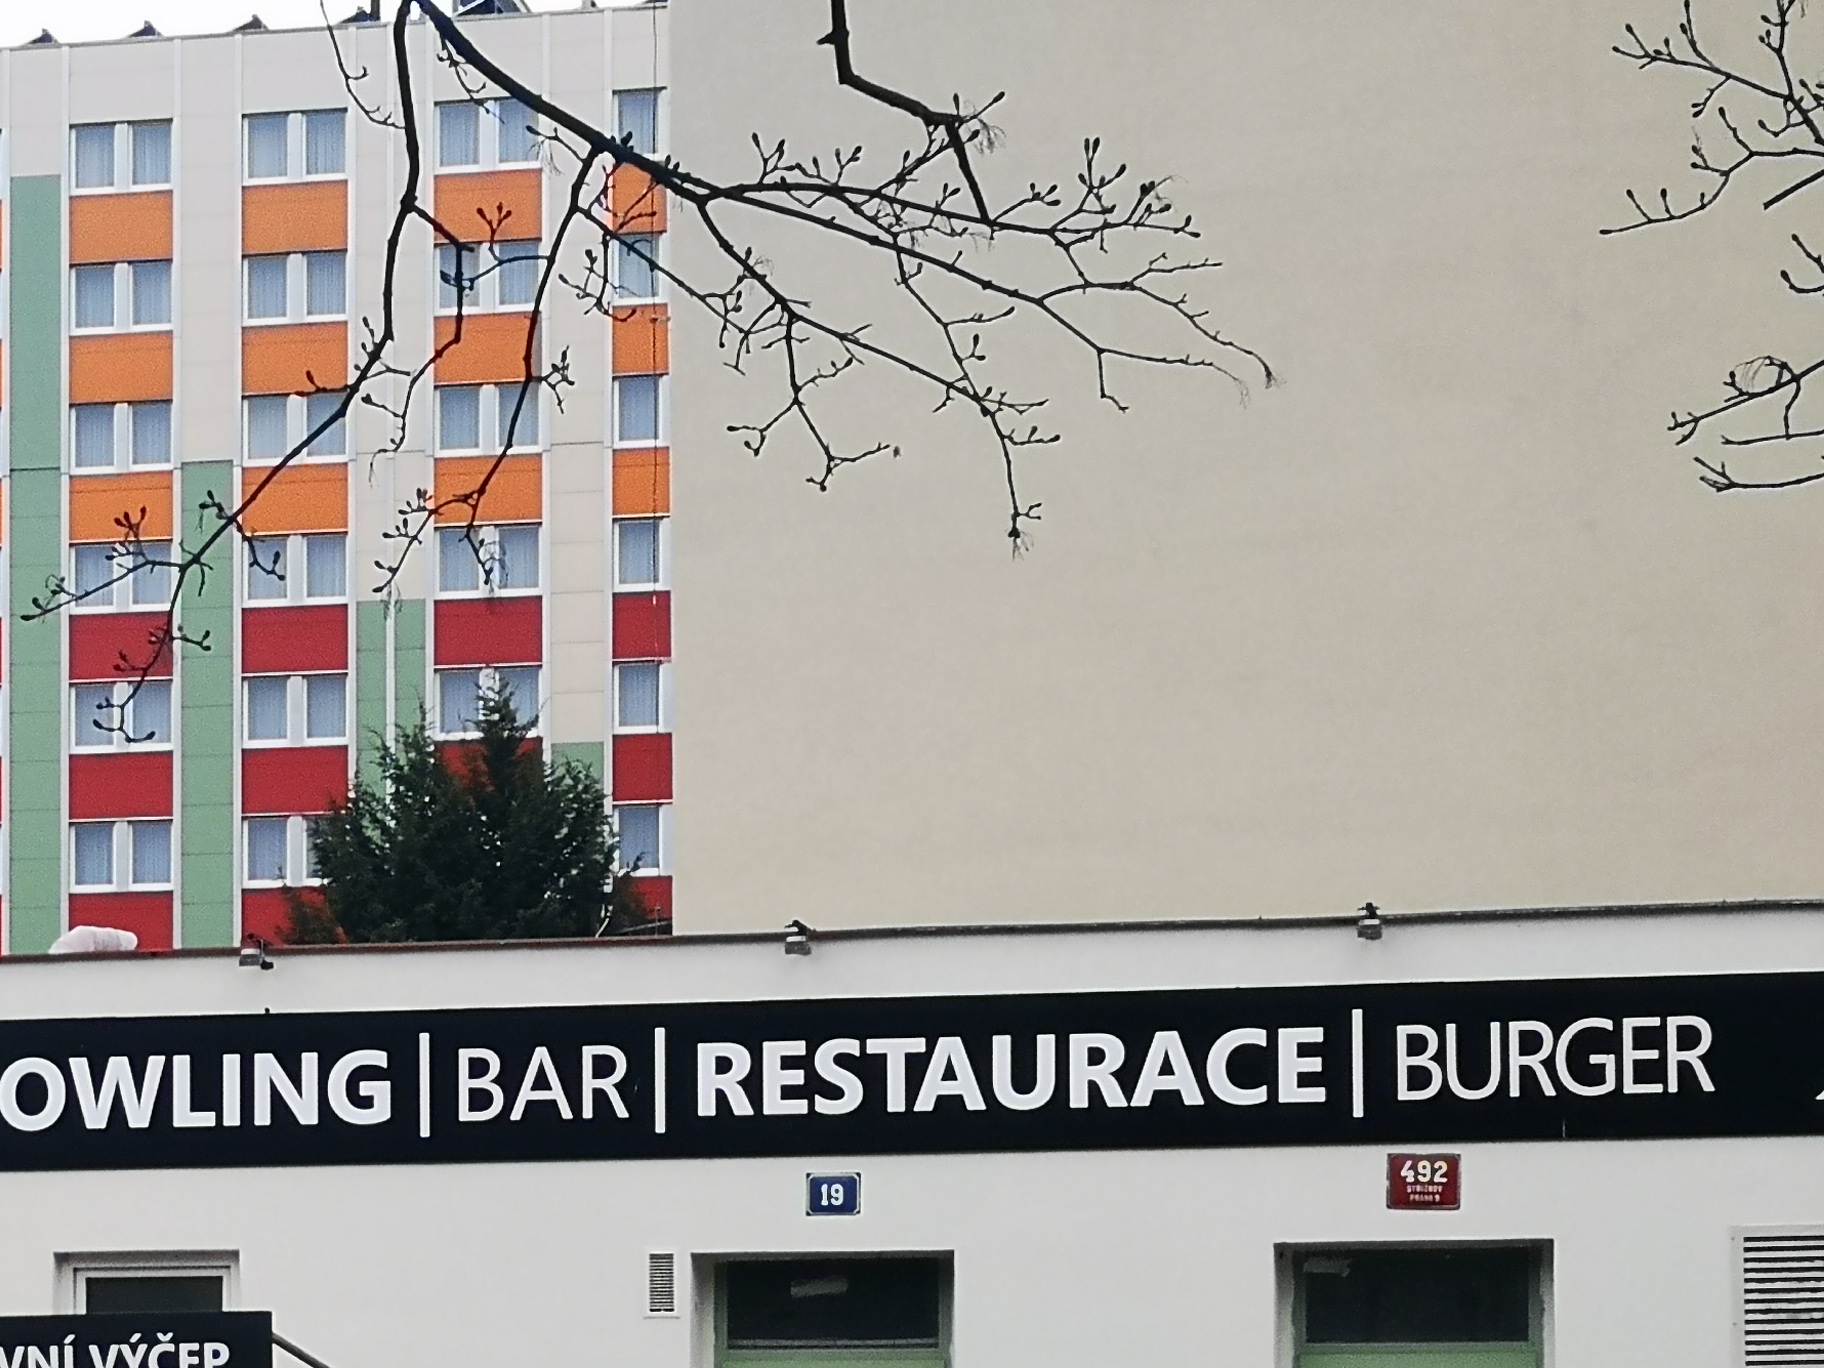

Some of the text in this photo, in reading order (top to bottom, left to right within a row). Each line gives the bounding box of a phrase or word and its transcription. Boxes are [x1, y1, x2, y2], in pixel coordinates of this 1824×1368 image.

[458, 1044, 630, 1122] BAR
[697, 1026, 1326, 1117] RESTAURACE
[1396, 1015, 1716, 1101] BURGER
[1400, 1160, 1448, 1183] 492
[821, 1183, 844, 1206] 19
